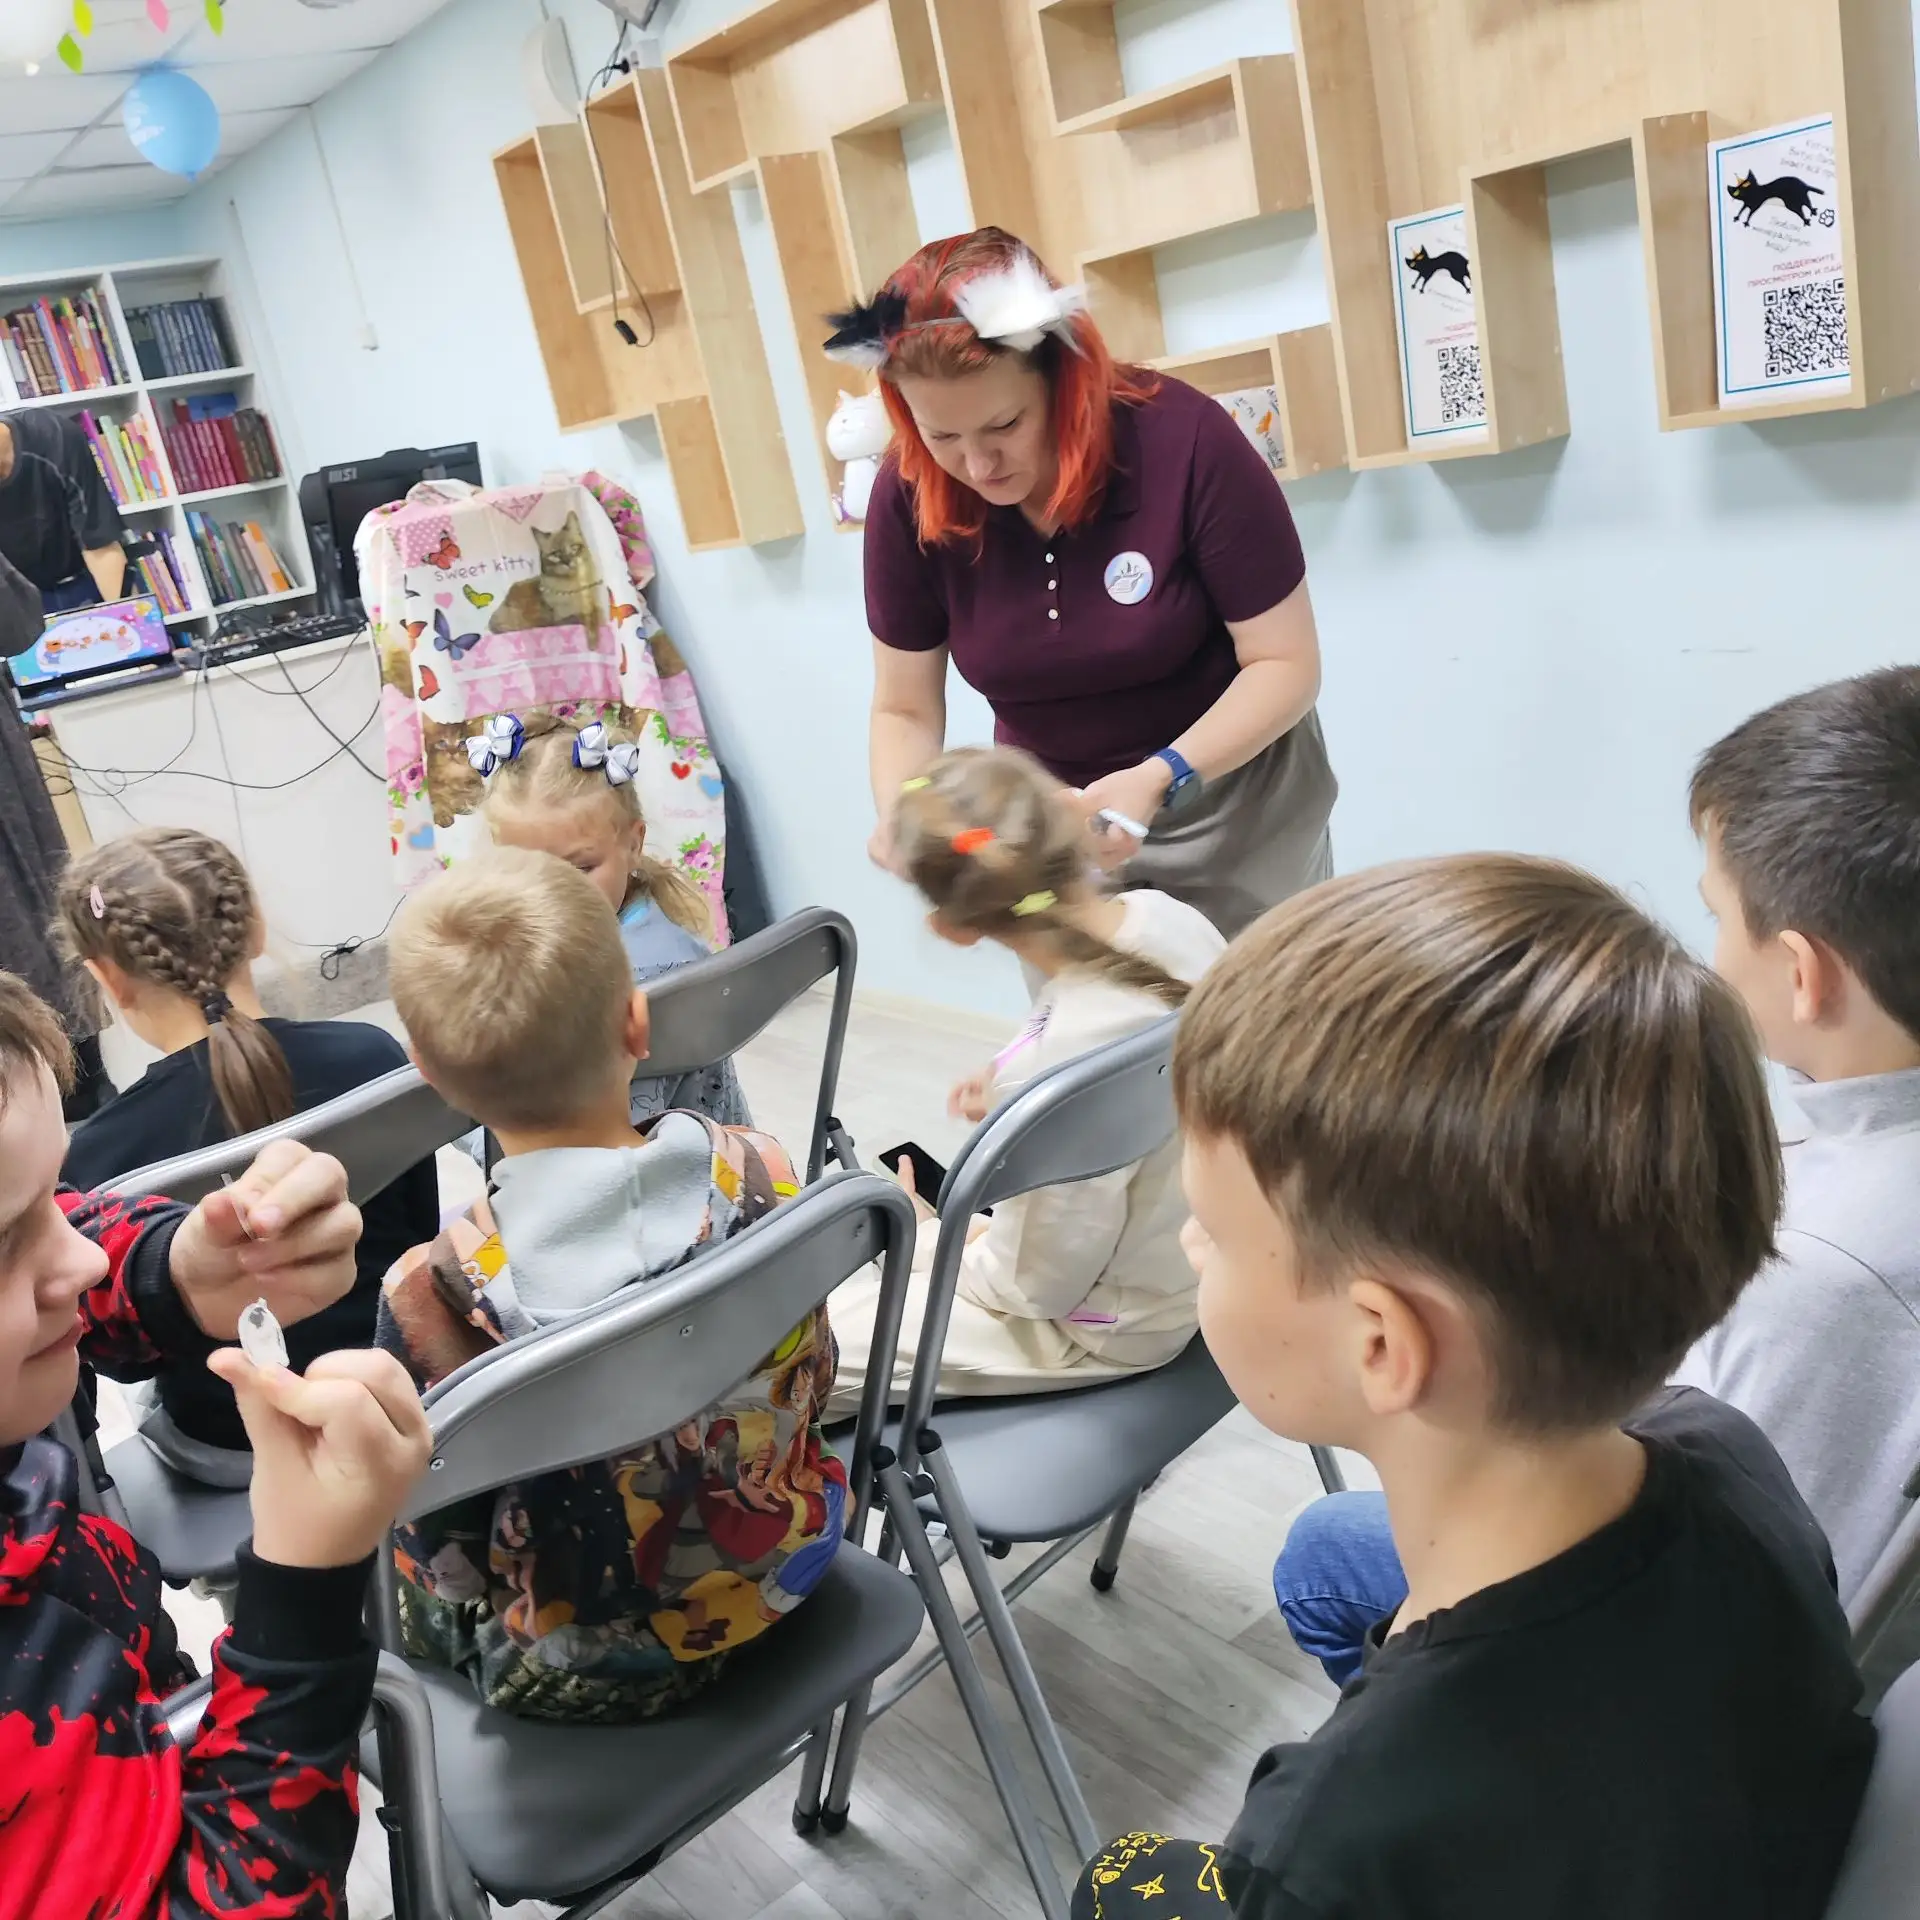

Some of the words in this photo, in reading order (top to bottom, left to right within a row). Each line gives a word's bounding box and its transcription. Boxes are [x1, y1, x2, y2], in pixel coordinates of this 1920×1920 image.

[1773, 253, 1834, 271] ПОДДЕРЖИТЕ
[1748, 269, 1812, 287] ПРОСМОТРОМ
[434, 564, 487, 582] sweet
[494, 556, 535, 573] kitty
